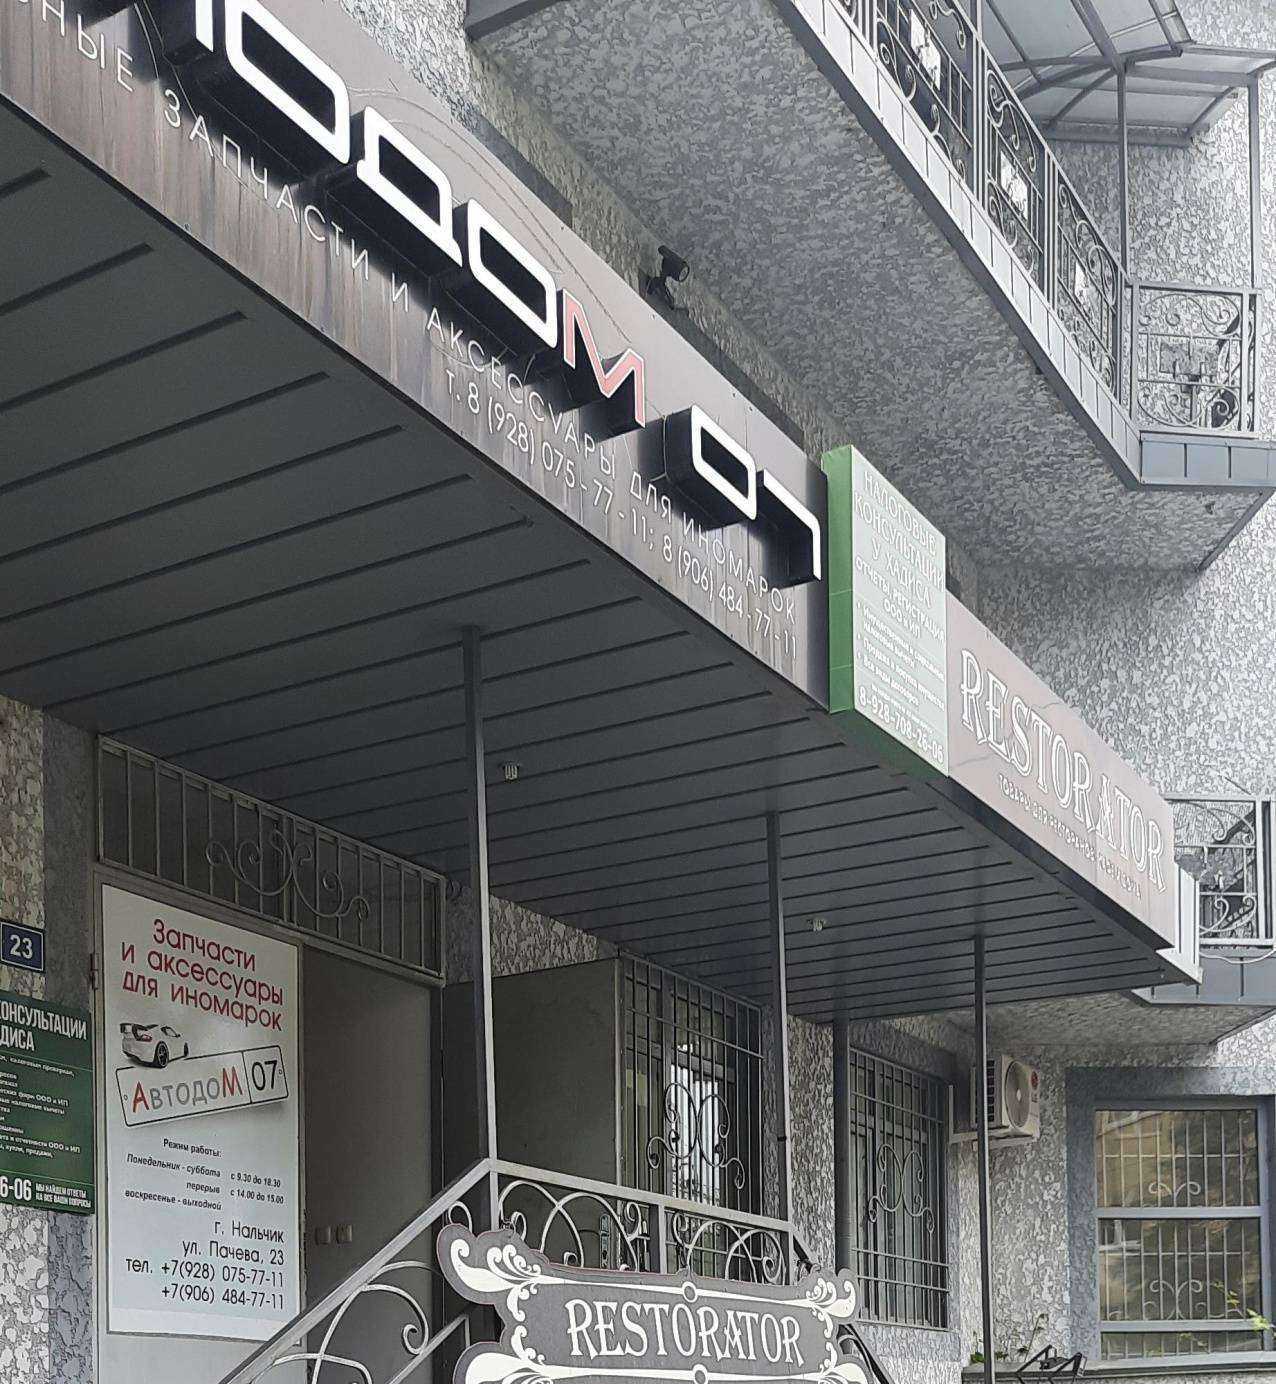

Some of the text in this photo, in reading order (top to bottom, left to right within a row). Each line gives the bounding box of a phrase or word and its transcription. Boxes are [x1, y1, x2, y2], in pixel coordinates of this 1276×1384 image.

[18, 0, 134, 92] НЫЕ
[164, 89, 369, 281] ЗАПЧАСТИ
[391, 272, 409, 313] И
[630, 472, 672, 523] ДЛЯ
[683, 512, 795, 624] ИНОМАРОК
[468, 382, 479, 414] 8
[488, 396, 535, 465] (928)
[662, 535, 673, 562] 8
[678, 545, 714, 601] (906)
[691, 404, 821, 580] 07
[864, 471, 936, 556] НАЛОГОВЫЕ
[855, 492, 944, 592] КОНСУЛЬТАЦИИ
[872, 538, 931, 608] У ХАДИСА
[859, 686, 944, 764] 8-928-708-26-06
[961, 648, 1166, 892] RESTORATOR
[10, 934, 33, 959] 23
[153, 918, 256, 971] Запчасти
[122, 942, 283, 1005] и аксессуары
[0, 1001, 87, 1040] ОНСУЛЬТАЦИИ
[123, 971, 282, 1031] для иномарок
[252, 1060, 278, 1091] 07
[127, 1153, 180, 1171] Понедельник
[186, 1165, 221, 1178] суббота
[253, 1175, 262, 1185] до
[163, 1138, 222, 1158] Режим работы:
[125, 1190, 176, 1204] воскресенье
[182, 1198, 222, 1211] выходной
[186, 1182, 220, 1194] перерыв
[256, 1192, 265, 1201] до
[182, 1240, 284, 1265] ул. Пачева, 23
[215, 1220, 284, 1243] г. Нальчик
[126, 1258, 284, 1287] тел. +7(928) 075-77-11
[162, 1283, 284, 1310] +7(906) 484-77-11
[565, 1298, 804, 1366] RESTORATOR
